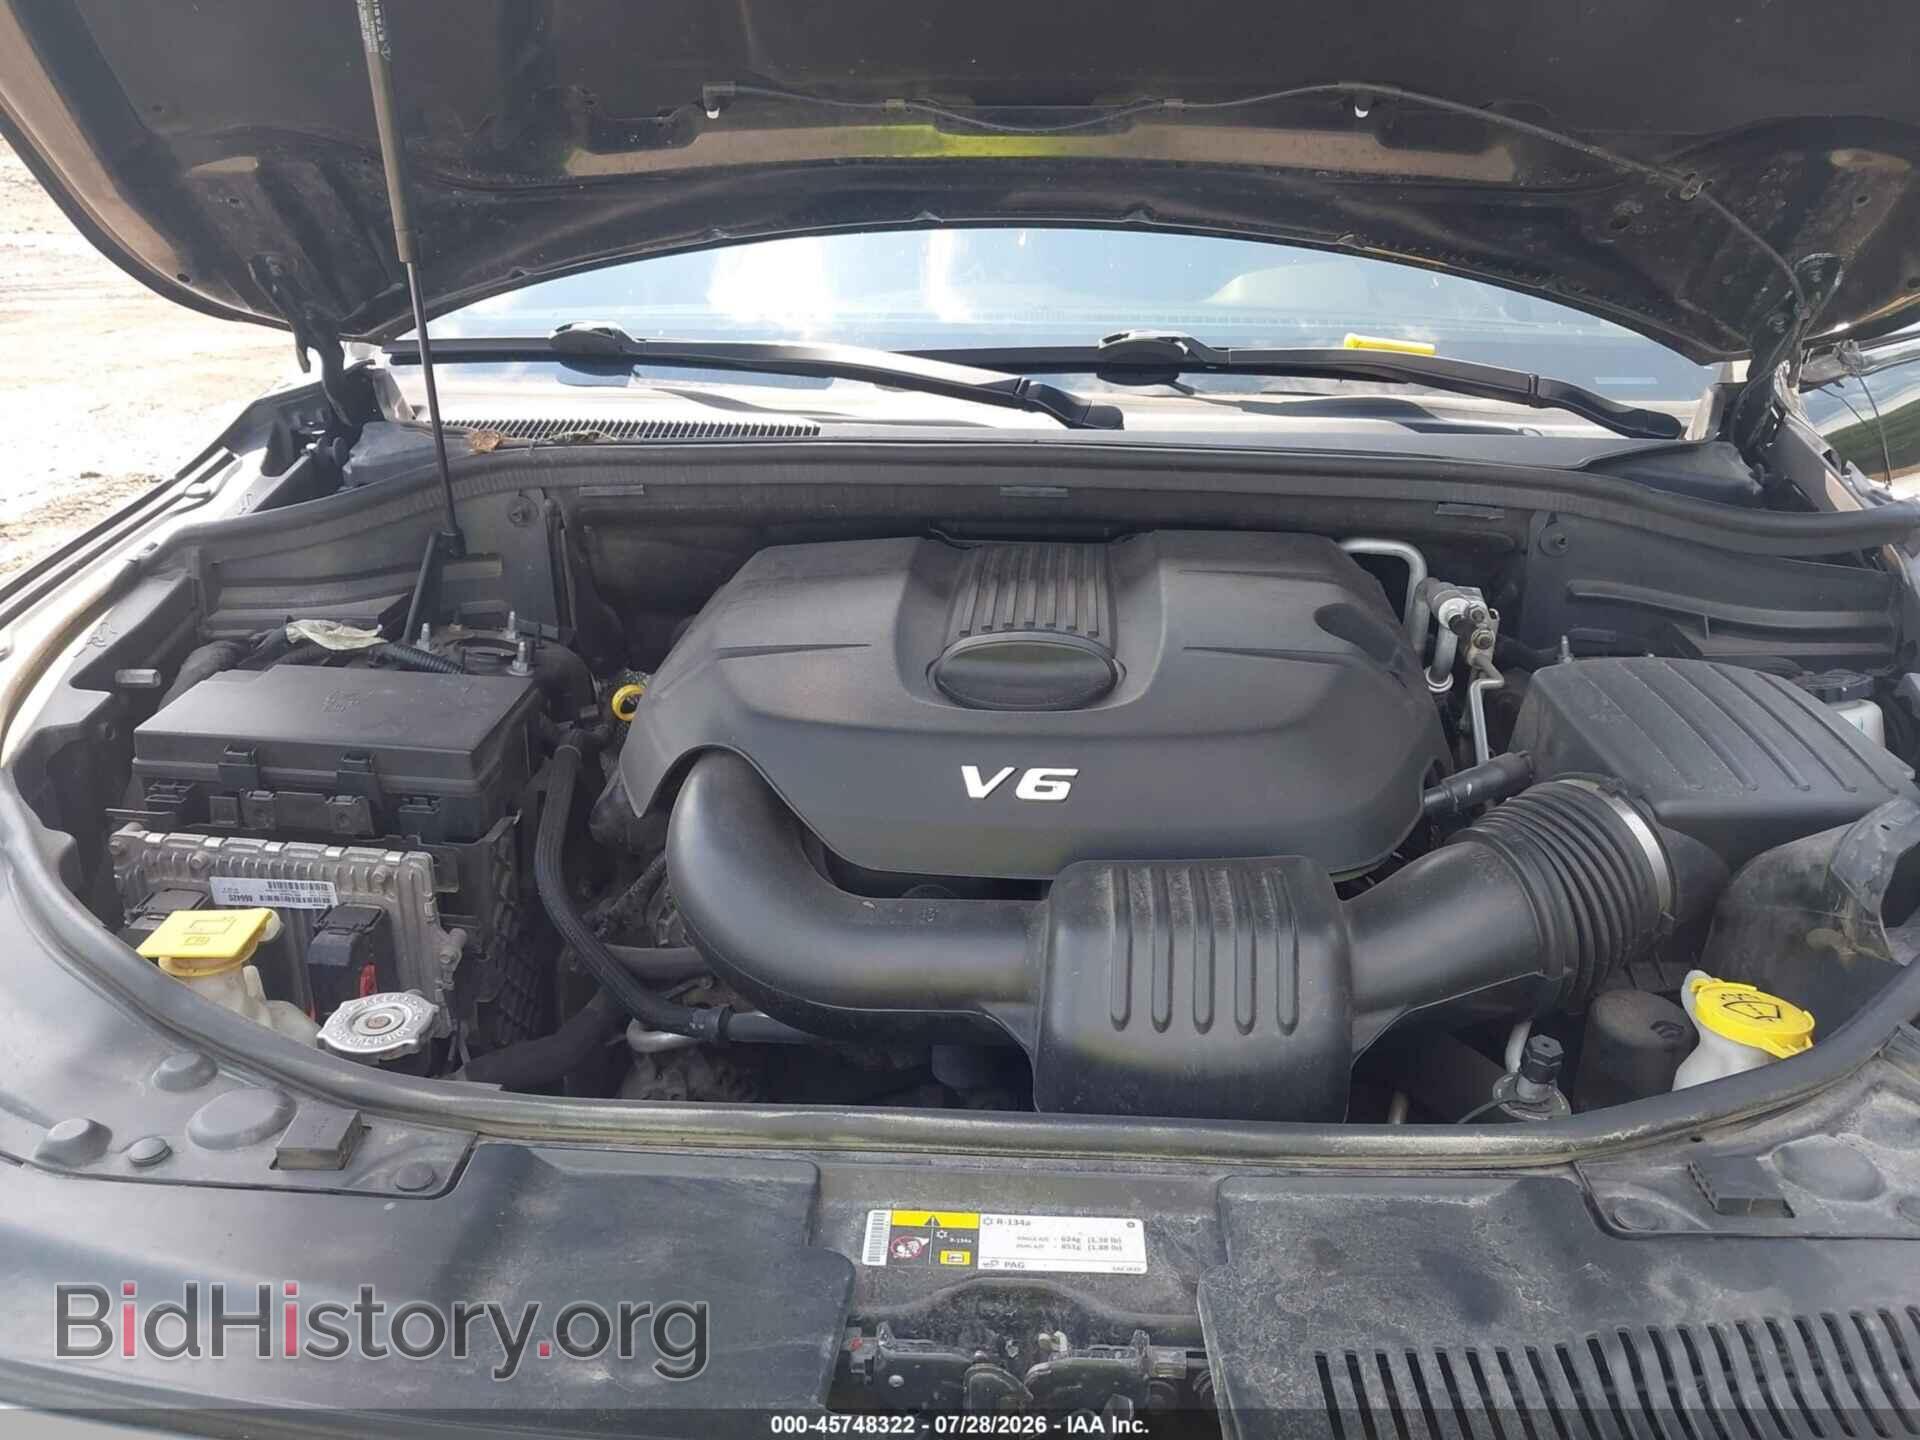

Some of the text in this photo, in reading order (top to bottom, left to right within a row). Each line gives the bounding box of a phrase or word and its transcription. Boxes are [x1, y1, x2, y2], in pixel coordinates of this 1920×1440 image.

[960, 764, 1080, 801] V6
[996, 1218, 1032, 1227] R-134a
[1060, 1236, 1081, 1244] 624g
[1003, 1261, 1026, 1269] PAG
